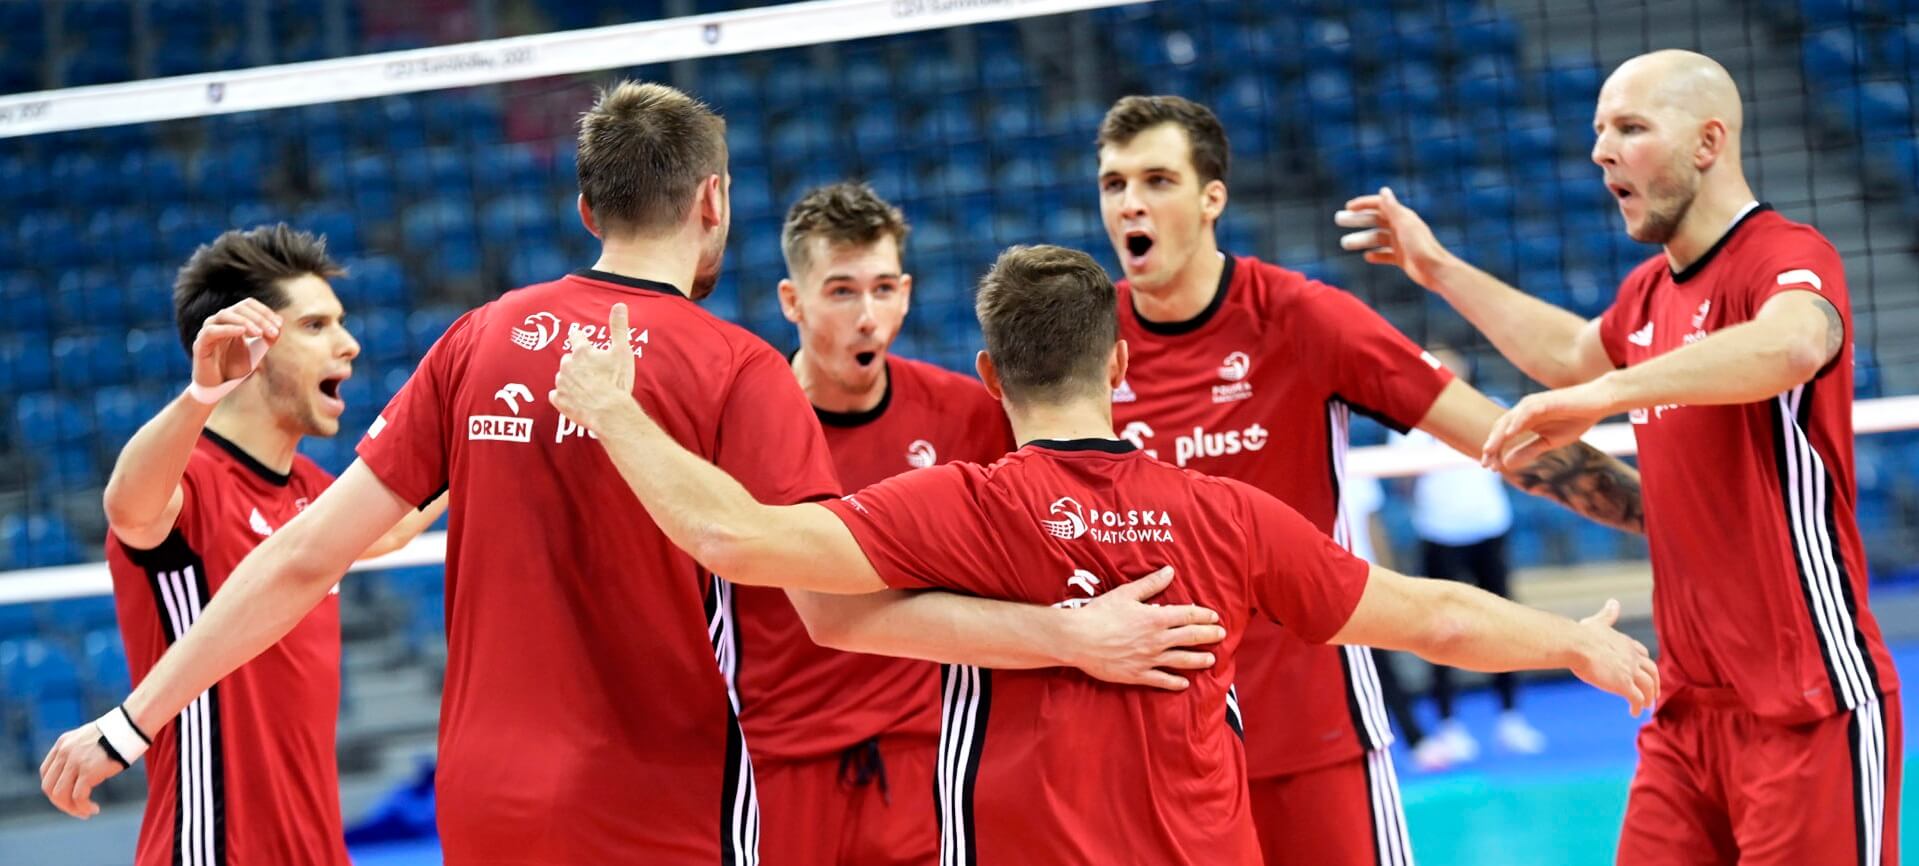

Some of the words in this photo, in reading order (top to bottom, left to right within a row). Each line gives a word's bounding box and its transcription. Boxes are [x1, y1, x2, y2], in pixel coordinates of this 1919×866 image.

[568, 322, 649, 344] POLKA
[471, 419, 528, 438] ORLEN
[1090, 509, 1172, 527] POLSKA
[1090, 526, 1174, 544] SIATKÓWKA
